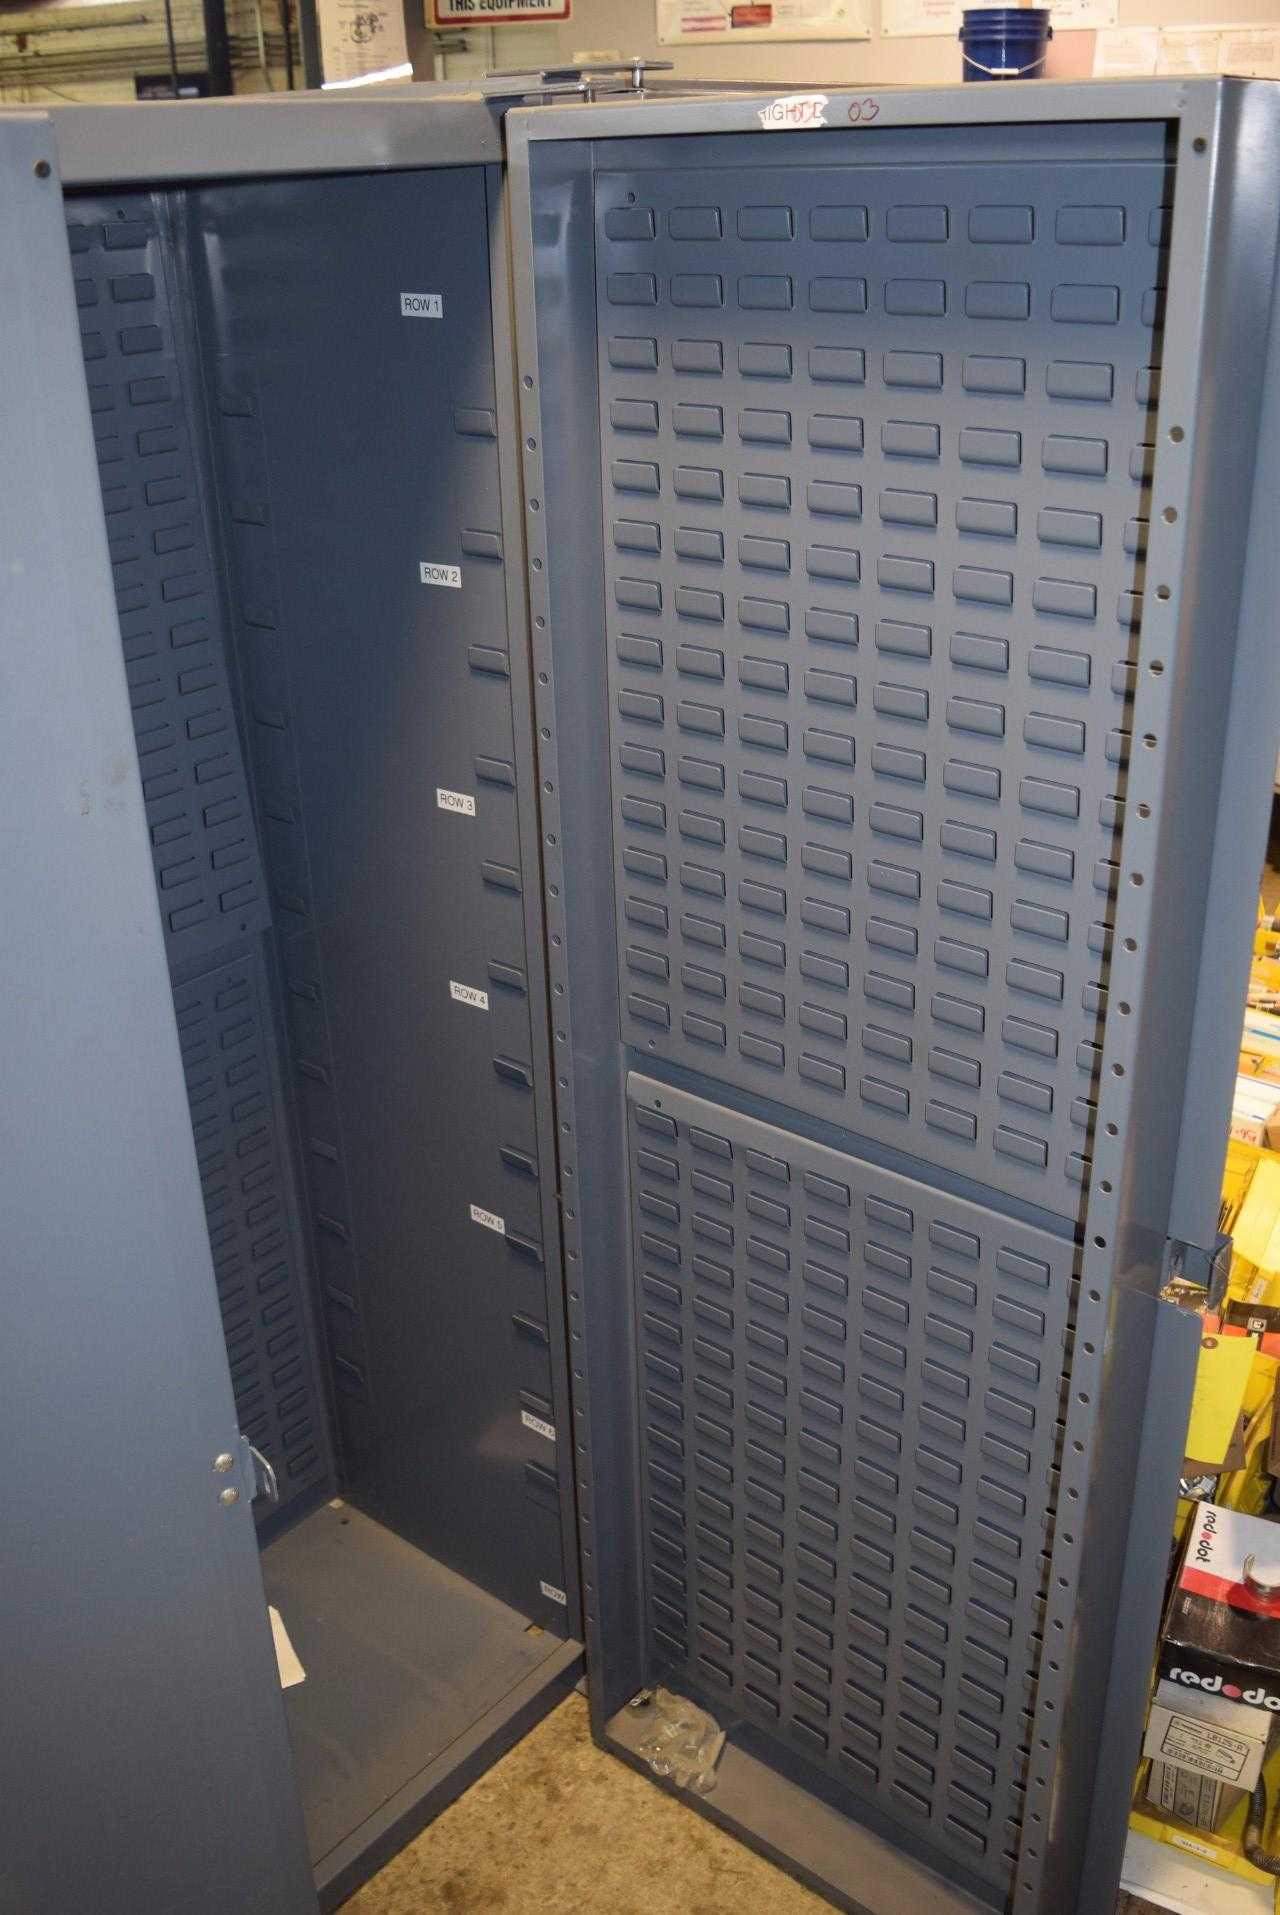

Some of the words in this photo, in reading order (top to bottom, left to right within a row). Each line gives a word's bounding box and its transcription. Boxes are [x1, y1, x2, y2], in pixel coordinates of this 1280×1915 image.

[449, 0, 475, 11] THIS
[479, 0, 553, 11] EQUIPMENT
[404, 297, 430, 311] ROW
[424, 566, 449, 581] ROW
[451, 571, 458, 582] 2
[440, 793, 464, 808] ROW
[467, 800, 473, 811] 3
[454, 984, 477, 1000] ROW
